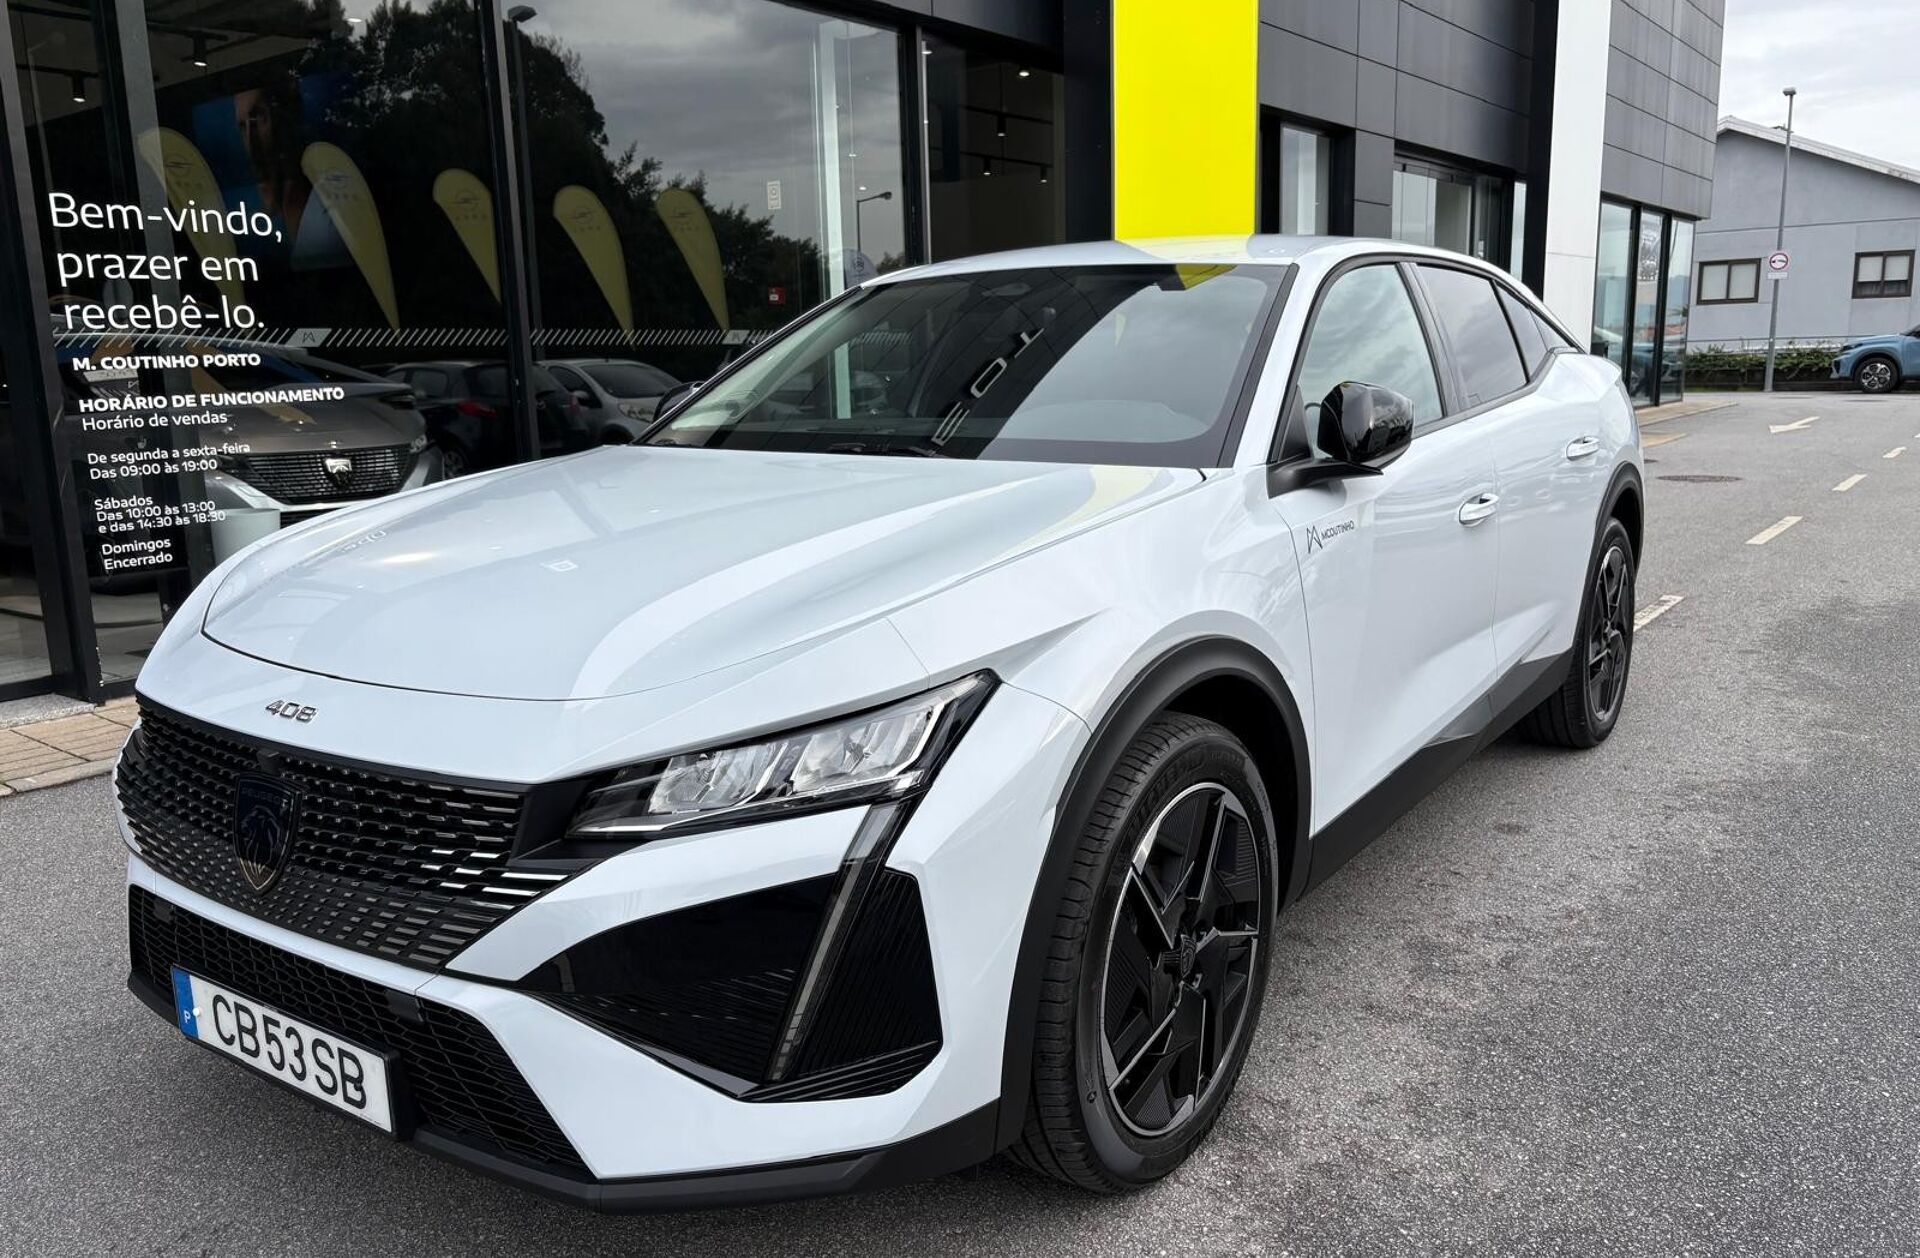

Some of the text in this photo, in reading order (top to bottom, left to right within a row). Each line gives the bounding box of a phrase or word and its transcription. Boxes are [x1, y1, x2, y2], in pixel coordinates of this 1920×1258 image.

[48, 192, 283, 243] Bem-vindo,
[57, 253, 259, 287] prazer em
[65, 294, 266, 329] recebê-lo.
[72, 353, 261, 371] M. COUTINHO PORTO
[79, 387, 345, 413] HORÁRIO DE FUNCIONAMENTO
[82, 410, 228, 431] Horário de vendas
[87, 442, 251, 465] De segunda a sexta-feira
[90, 458, 218, 480] Das 09:00 às 19:00
[94, 495, 154, 511] Sábados
[96, 500, 216, 523] Das 10:00 às 13:00
[98, 510, 226, 534] e das 14:30 às 18:30
[102, 538, 172, 556] Domingos
[104, 553, 173, 570] Encerrado
[265, 699, 318, 724] 408
[183, 1010, 191, 1025] P
[212, 994, 367, 1109] CB53SB
